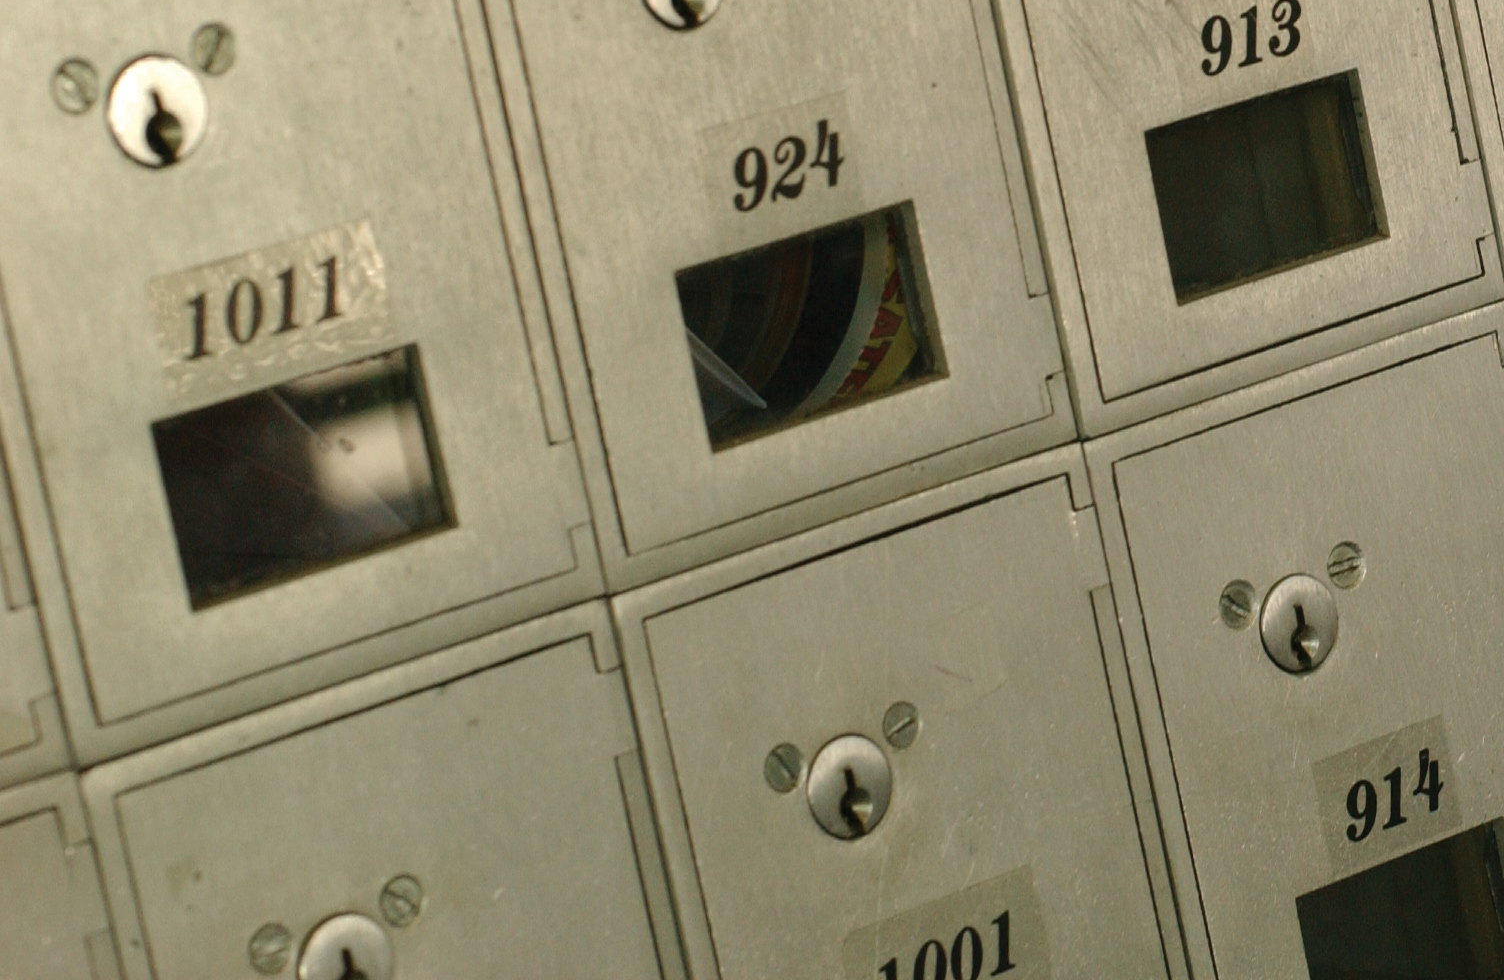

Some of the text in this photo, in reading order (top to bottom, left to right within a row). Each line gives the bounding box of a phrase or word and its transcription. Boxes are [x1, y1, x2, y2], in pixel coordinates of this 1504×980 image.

[734, 120, 844, 212] 924
[186, 257, 345, 362] 1011
[1347, 748, 1444, 842] 914
